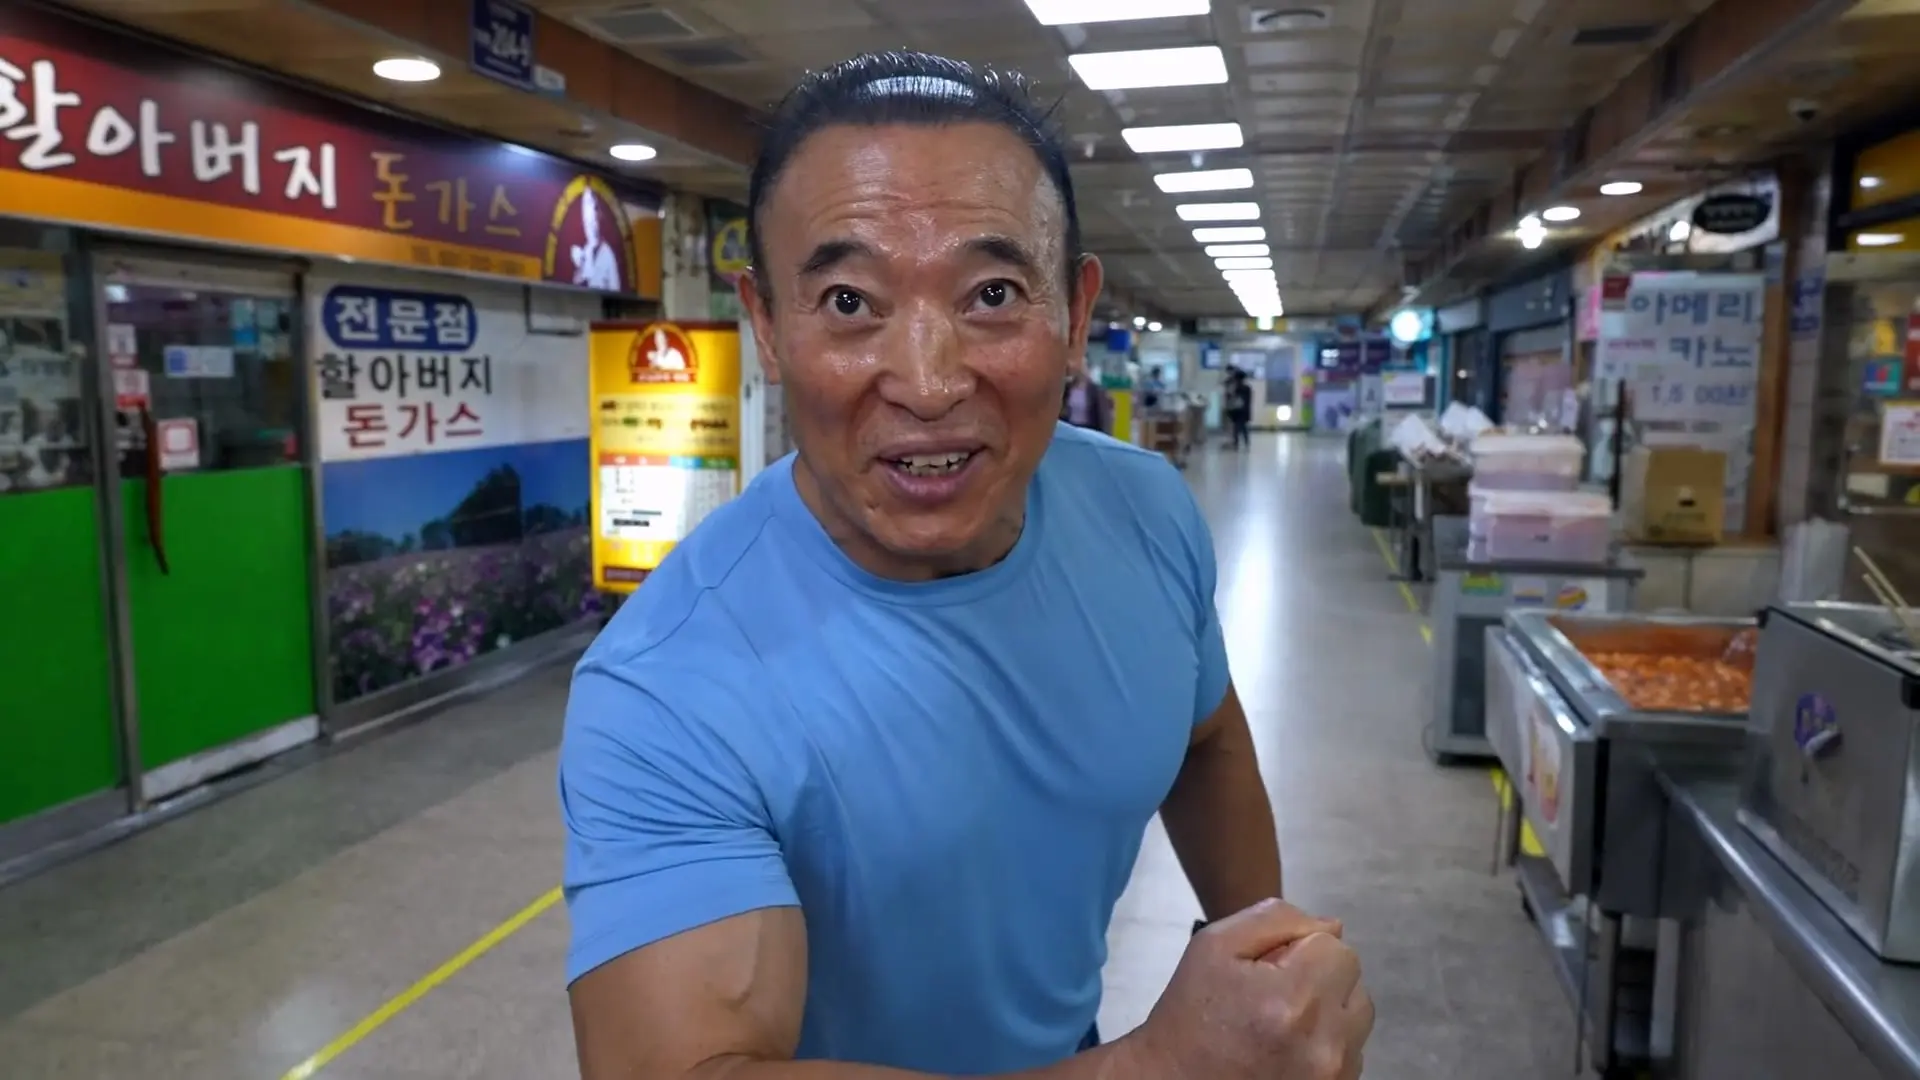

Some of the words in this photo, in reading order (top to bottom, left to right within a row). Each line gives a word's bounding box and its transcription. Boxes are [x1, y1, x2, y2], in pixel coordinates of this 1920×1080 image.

[0, 60, 337, 209] 할아버지
[370, 151, 521, 237] 돈가스
[333, 295, 471, 345] 전문점
[1630, 291, 1754, 326] 아메리
[1669, 336, 1752, 368] 카노
[315, 353, 493, 400] 할아버지
[342, 401, 484, 448] 돈가스
